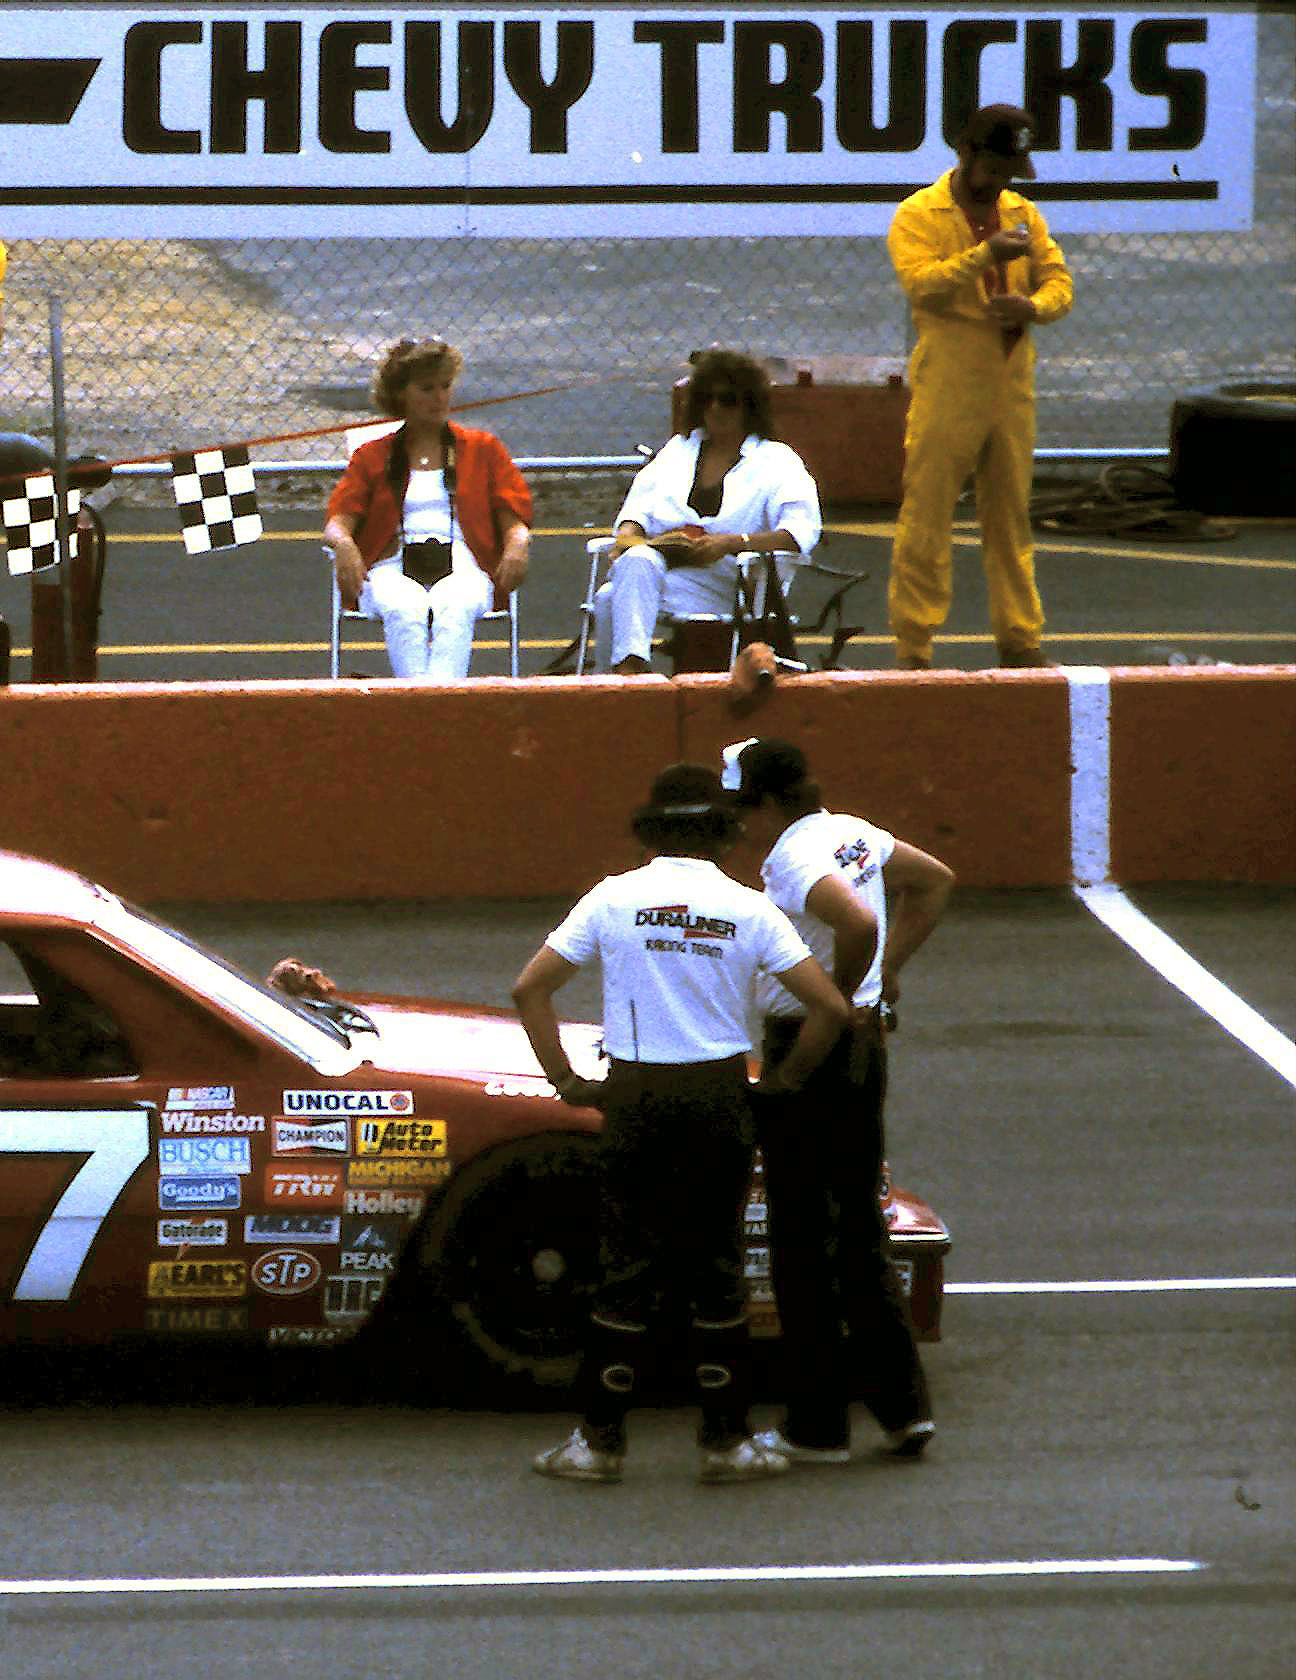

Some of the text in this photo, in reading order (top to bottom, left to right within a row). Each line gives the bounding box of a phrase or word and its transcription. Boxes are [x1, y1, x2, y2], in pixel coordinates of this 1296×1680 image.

[122, 19, 1209, 154] CHEVY TRUCKS
[635, 910, 737, 938] DURALINER
[287, 1093, 389, 1111] UNOCAL
[161, 1112, 266, 1133] Winston
[385, 1122, 434, 1137] Auto
[278, 1129, 346, 1144] CHAMPION
[160, 1140, 248, 1162] BUSCH
[349, 1160, 451, 1178] MICHIGAN
[271, 1173, 338, 1197] TRW
[345, 1190, 423, 1220] Holley
[162, 1224, 223, 1238] Gatorade
[260, 1255, 311, 1285] STP
[341, 1252, 394, 1270] PEAK
